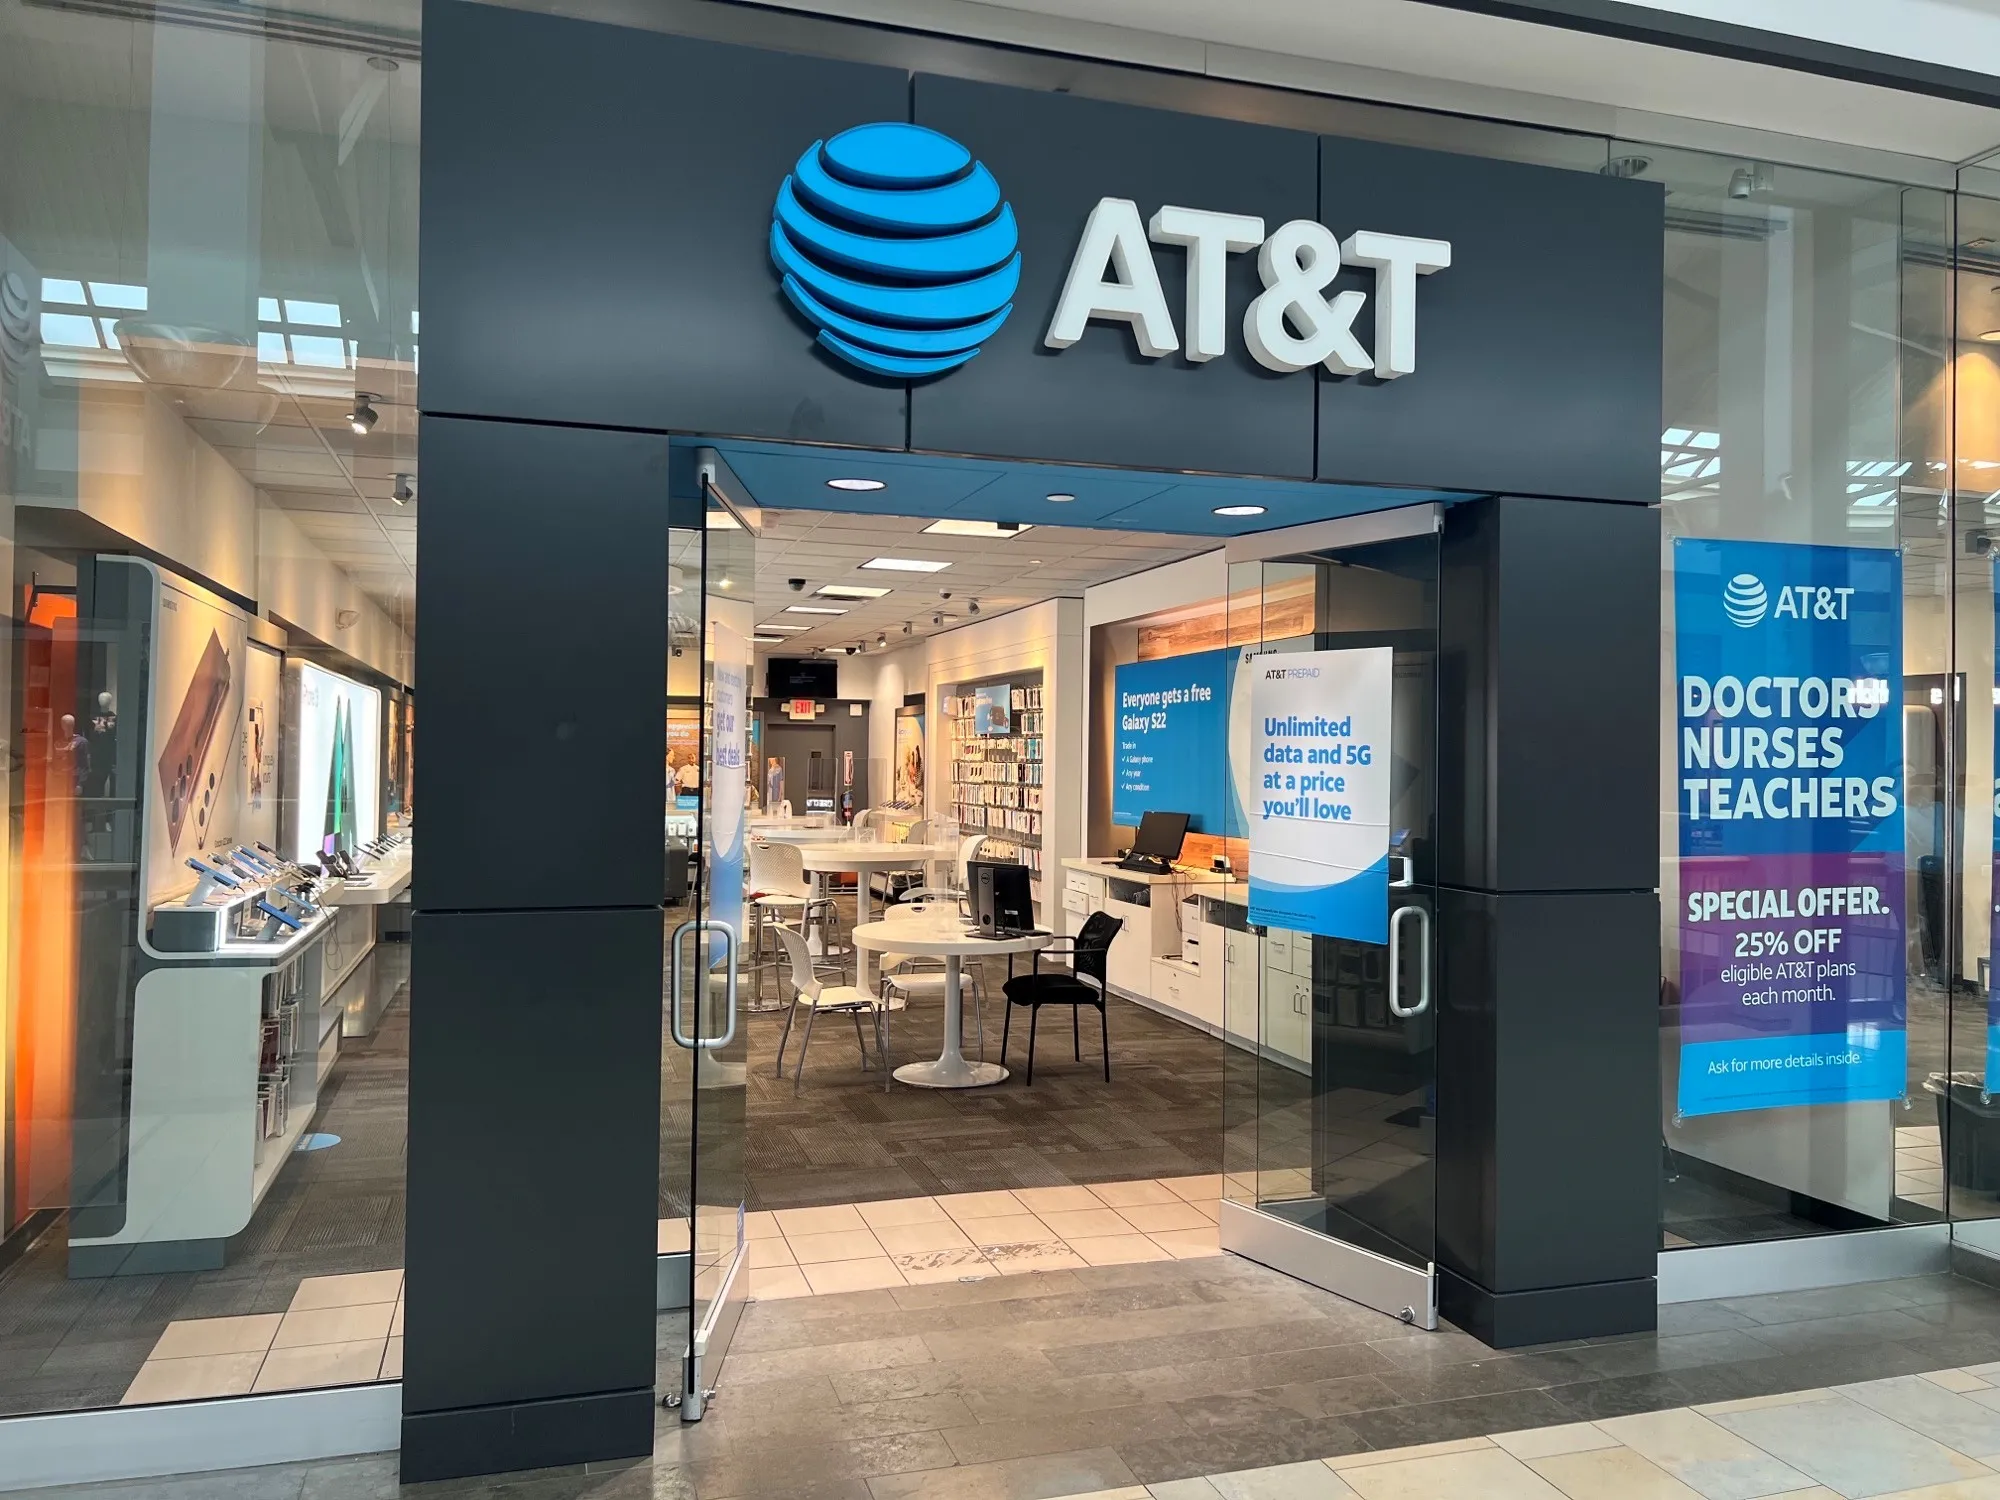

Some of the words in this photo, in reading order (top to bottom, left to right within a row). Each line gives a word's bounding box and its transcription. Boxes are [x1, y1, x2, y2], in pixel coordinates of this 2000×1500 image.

[1044, 197, 1452, 380] AT&T
[1774, 585, 1855, 621] AT&T
[1265, 669, 1287, 680] AT&T
[1288, 667, 1320, 679] PREPAID
[795, 702, 811, 713] EXIT
[1122, 692, 1160, 711] Everyone
[1161, 687, 1182, 709] gets
[1183, 689, 1189, 702] a
[1191, 683, 1211, 701] free
[1683, 676, 1881, 719] DOCTORS
[1122, 713, 1150, 734] Galaxy
[1151, 712, 1167, 729] S22
[1264, 716, 1351, 736] Unlimited
[1263, 743, 1303, 763] data
[1308, 744, 1341, 764] and
[1346, 745, 1371, 765] 5G
[1683, 727, 1844, 769] NURSES
[1263, 772, 1281, 790] at
[1285, 775, 1295, 790] a
[1300, 771, 1345, 796] price
[1314, 798, 1352, 820] love
[1683, 776, 1898, 820] TEACHERS
[1687, 889, 1795, 923] SPECIAL
[1798, 886, 1890, 918] OFFER.
[1735, 931, 1788, 957] 25%
[1794, 928, 1842, 955] OFF
[1720, 963, 1773, 987] eligible
[1776, 961, 1814, 980] AT&T
[1817, 960, 1856, 986] plans
[1742, 986, 1778, 1006] each
[1782, 984, 1836, 1004] month.
[1707, 1058, 1730, 1075] Ask
[1731, 1056, 1748, 1073] for
[1750, 1057, 1782, 1071] more
[1785, 1052, 1824, 1069] details
[1825, 1050, 1863, 1067] inside.
